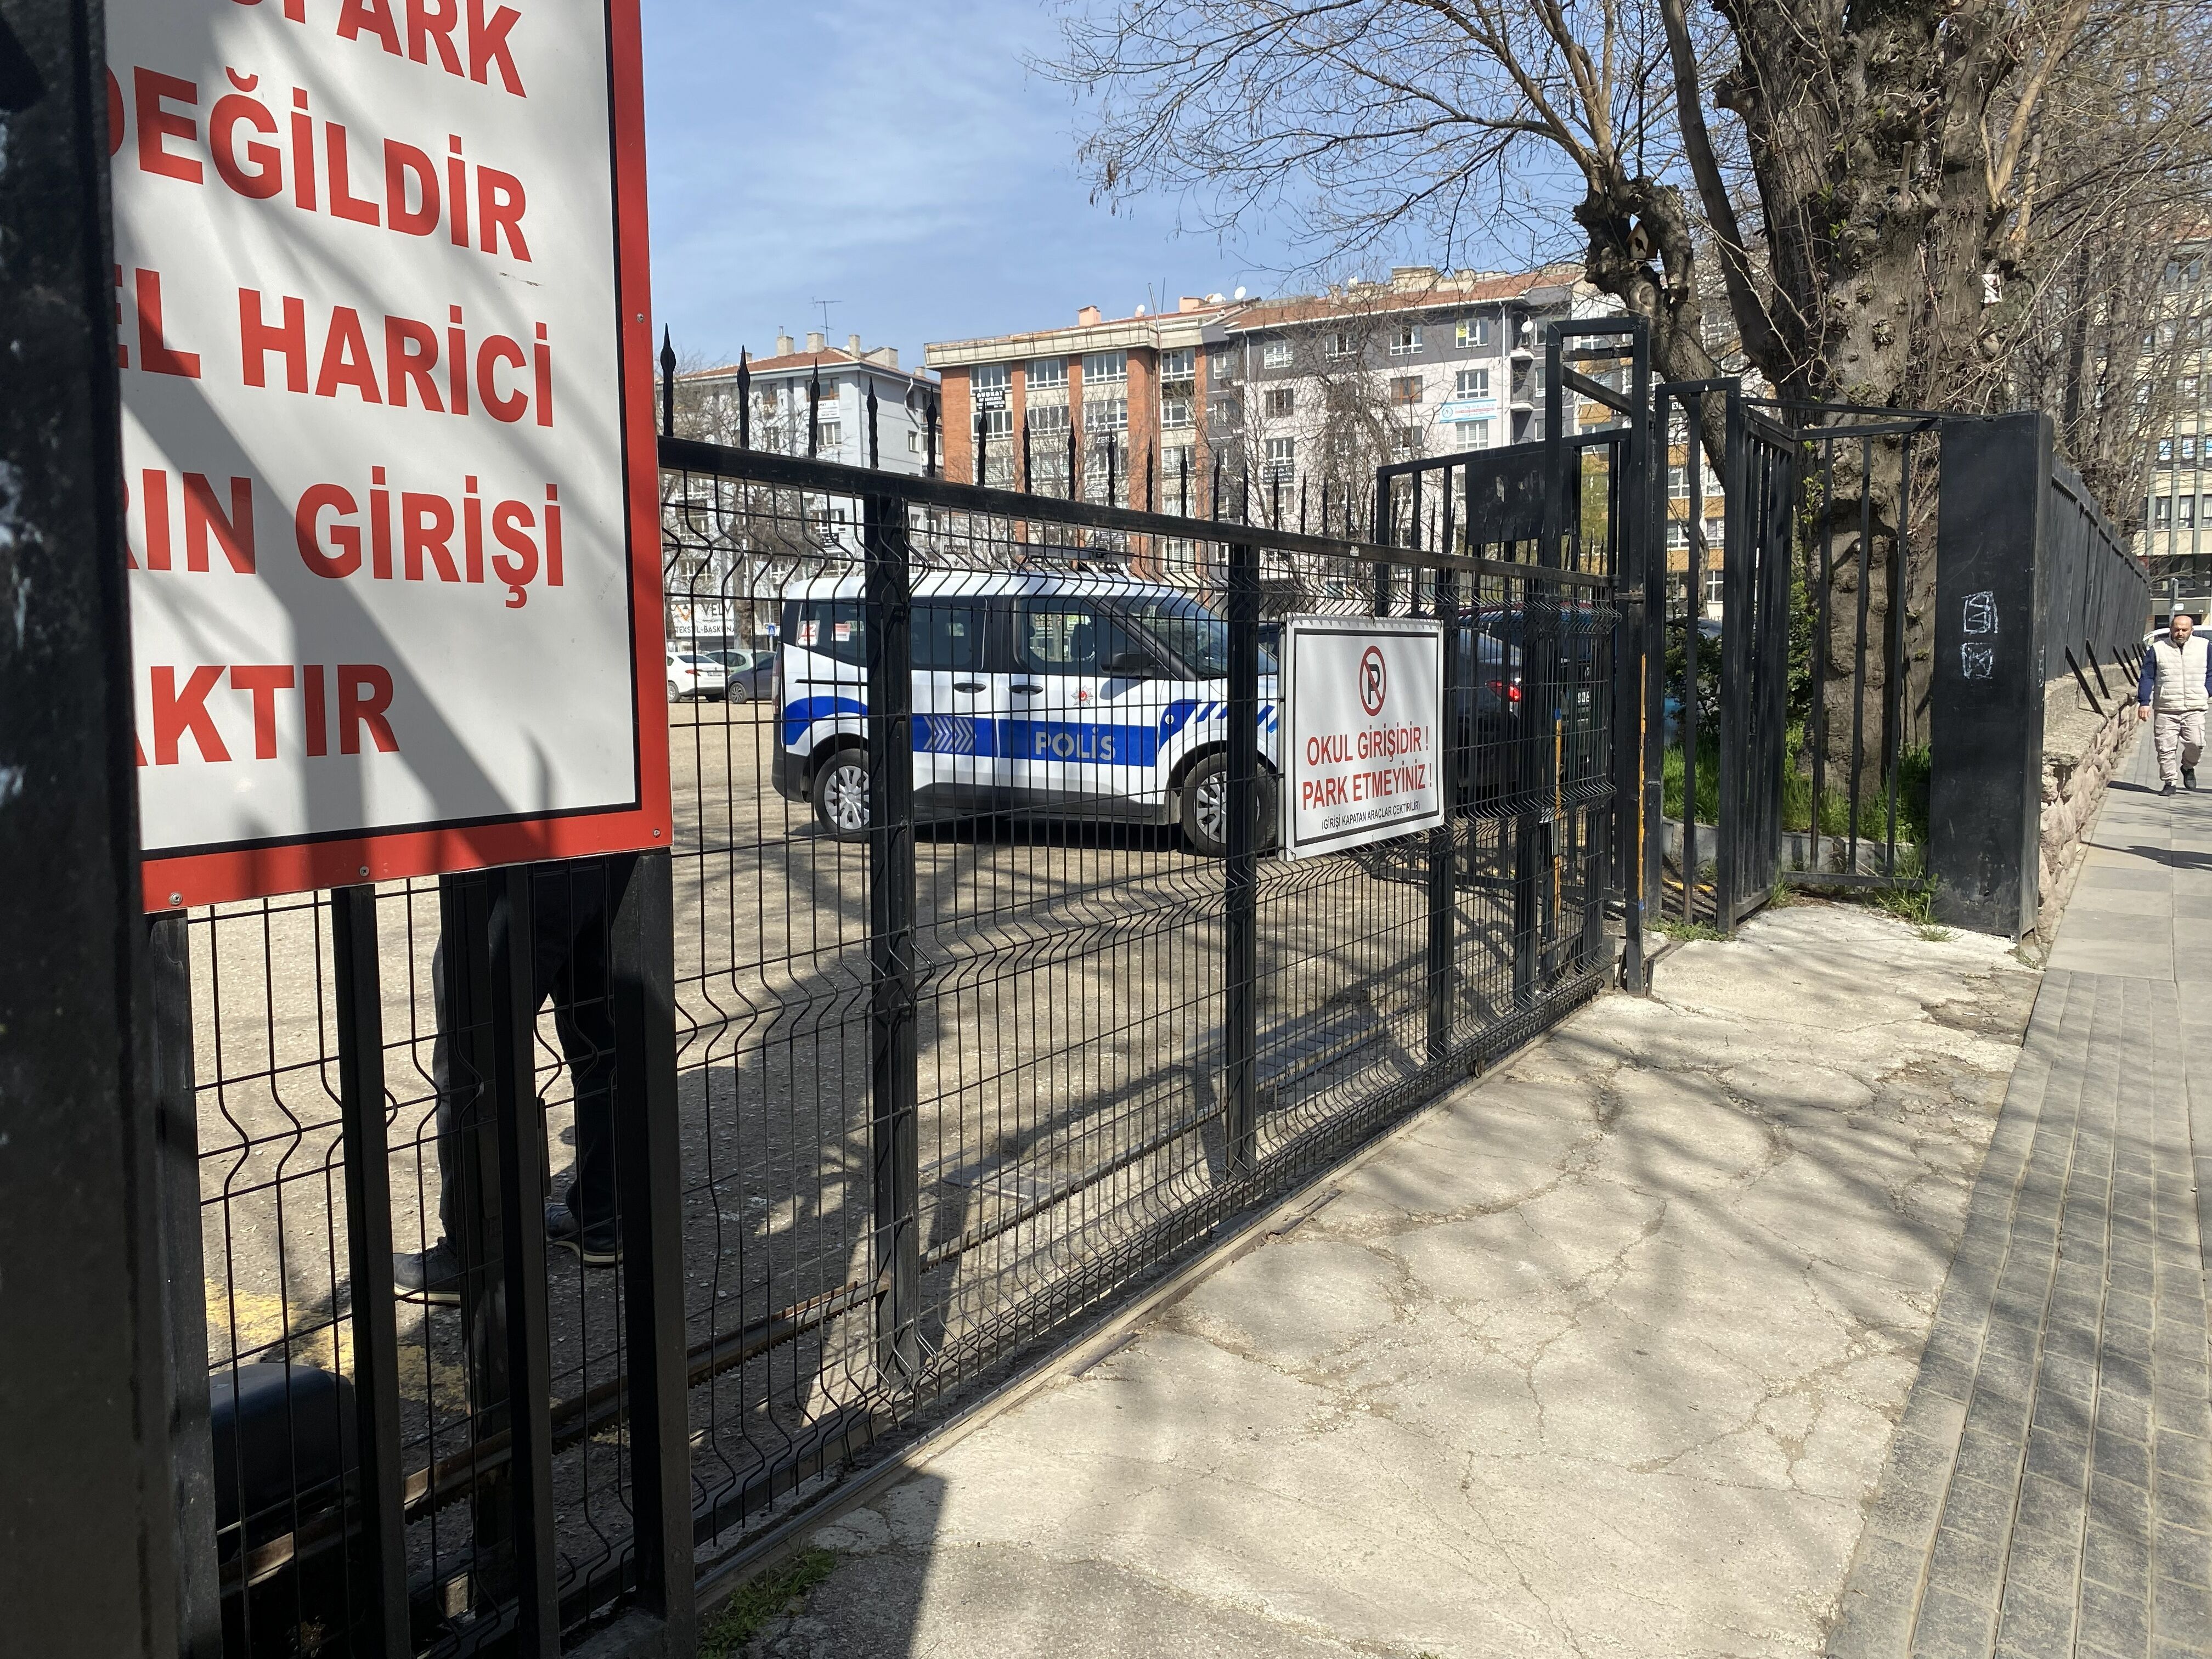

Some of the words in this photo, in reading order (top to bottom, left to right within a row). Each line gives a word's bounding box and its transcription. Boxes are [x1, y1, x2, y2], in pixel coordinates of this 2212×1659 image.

[230, 0, 527, 98] ARK
[114, 263, 201, 379] L
[239, 287, 553, 428] HARİCİ
[977, 390, 1003, 398] AVUKAT
[126, 469, 256, 574] IN
[296, 466, 563, 608] GİRİŞİ
[134, 664, 400, 767] KTIR
[1035, 726, 1116, 761] POLİS
[1307, 734, 1353, 766] OKUL
[1357, 720, 1422, 763] GİRİŞİDİR
[1303, 775, 1348, 811] PARK
[1353, 758, 1425, 801] ETMEYİNİZ
[1322, 814, 1341, 832] (GİRİŞİ
[1342, 811, 1366, 826] KAPATAN
[1367, 806, 1392, 821] ARAÇLAR
[1392, 799, 1420, 818] ÇEKTİRİLİR)
